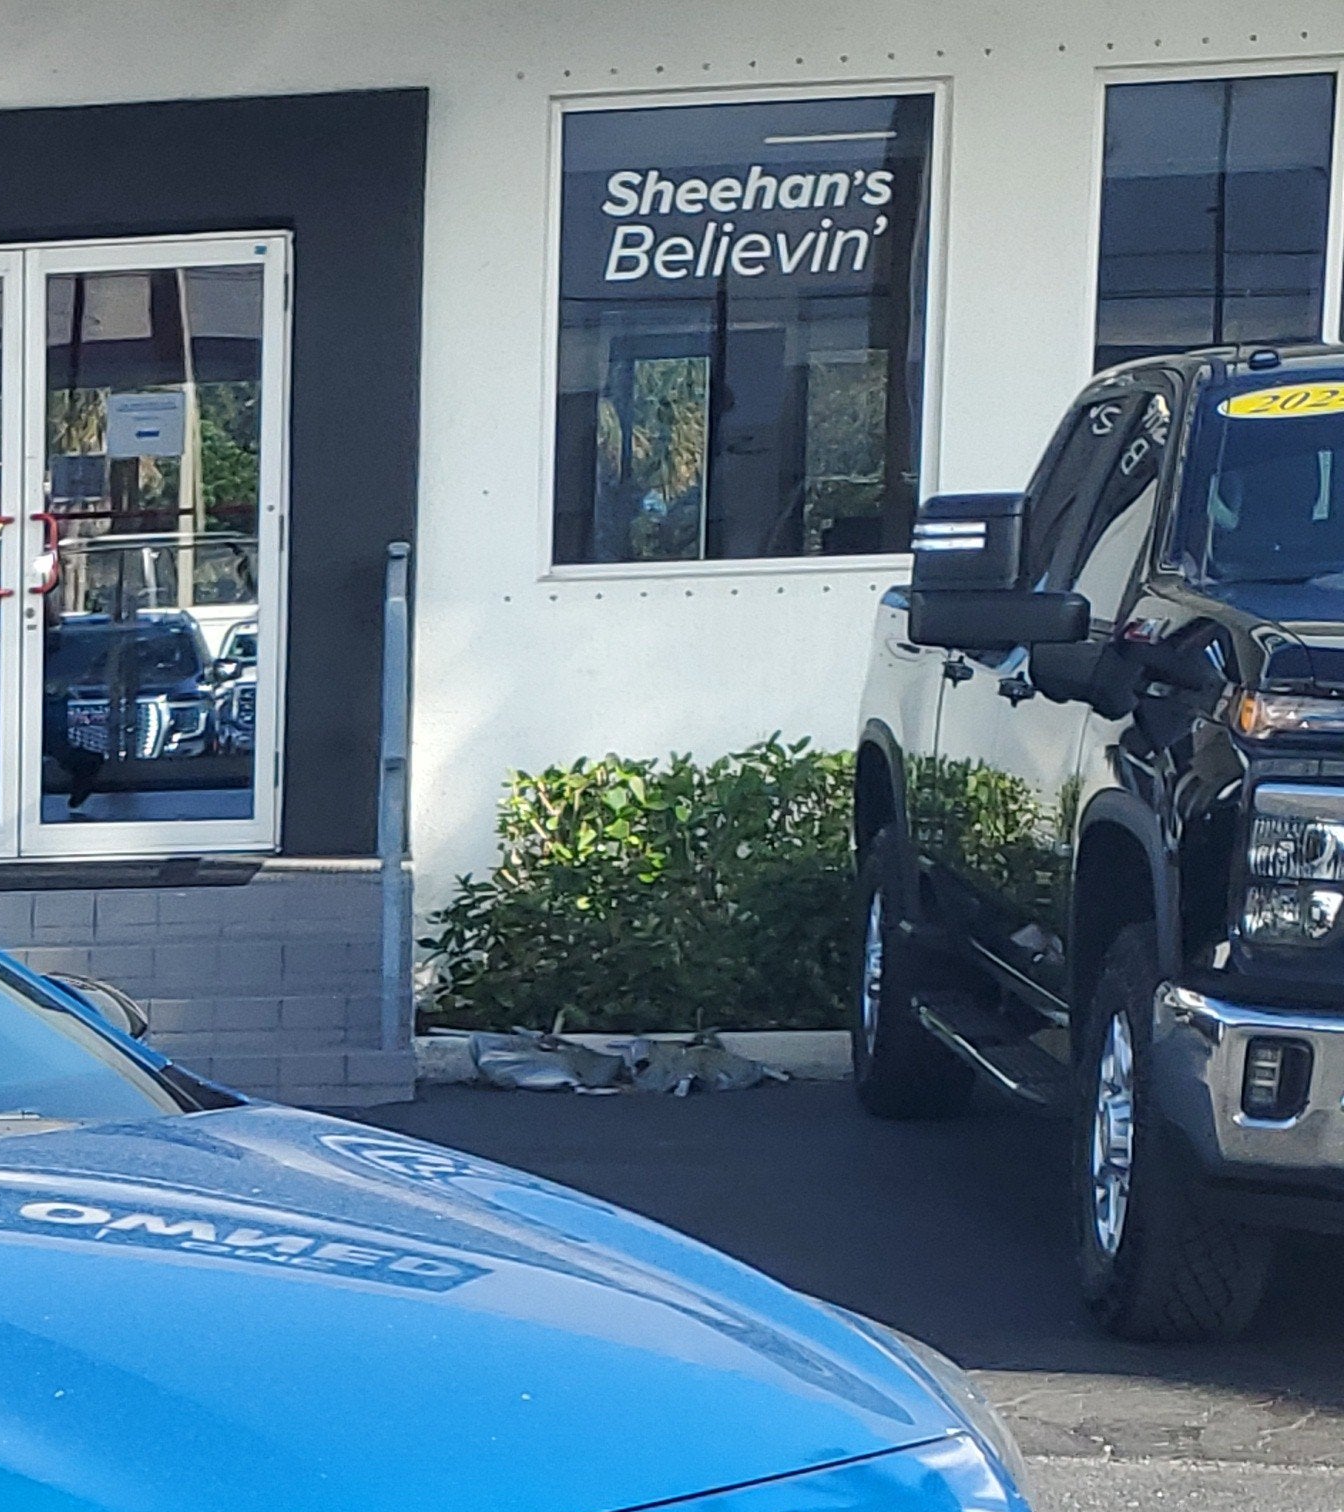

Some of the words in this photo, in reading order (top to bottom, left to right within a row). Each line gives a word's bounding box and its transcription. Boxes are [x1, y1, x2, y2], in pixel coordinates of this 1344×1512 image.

[602, 165, 894, 216] Sheehan's
[604, 216, 888, 280] Believin'
[1247, 389, 1344, 413] 202
